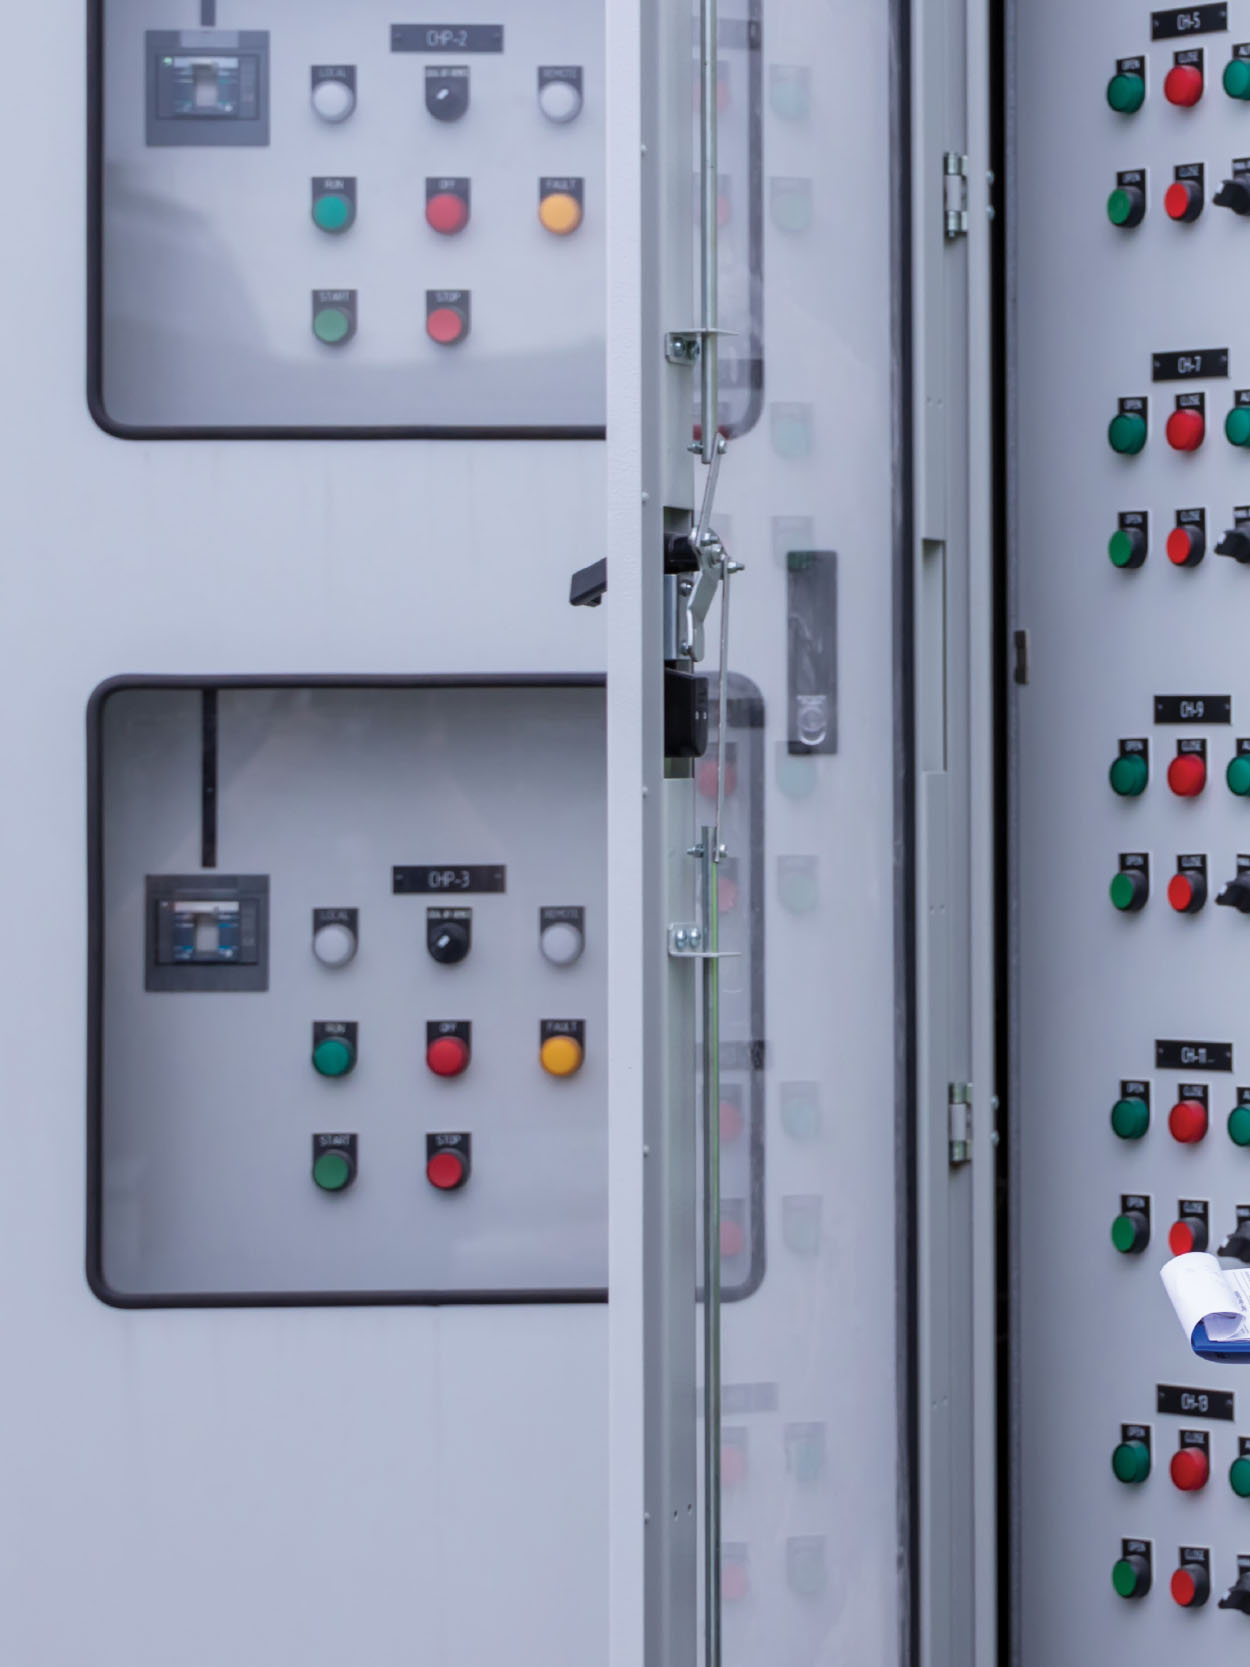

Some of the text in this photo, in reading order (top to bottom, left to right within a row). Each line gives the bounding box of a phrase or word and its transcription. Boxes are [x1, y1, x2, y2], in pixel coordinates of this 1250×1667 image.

[1177, 12, 1201, 31] CH-5
[426, 31, 467, 47] CHP-2
[1178, 355, 1201, 374] CH-7
[1180, 701, 1204, 719] CH-9
[428, 872, 470, 888] CHP-3
